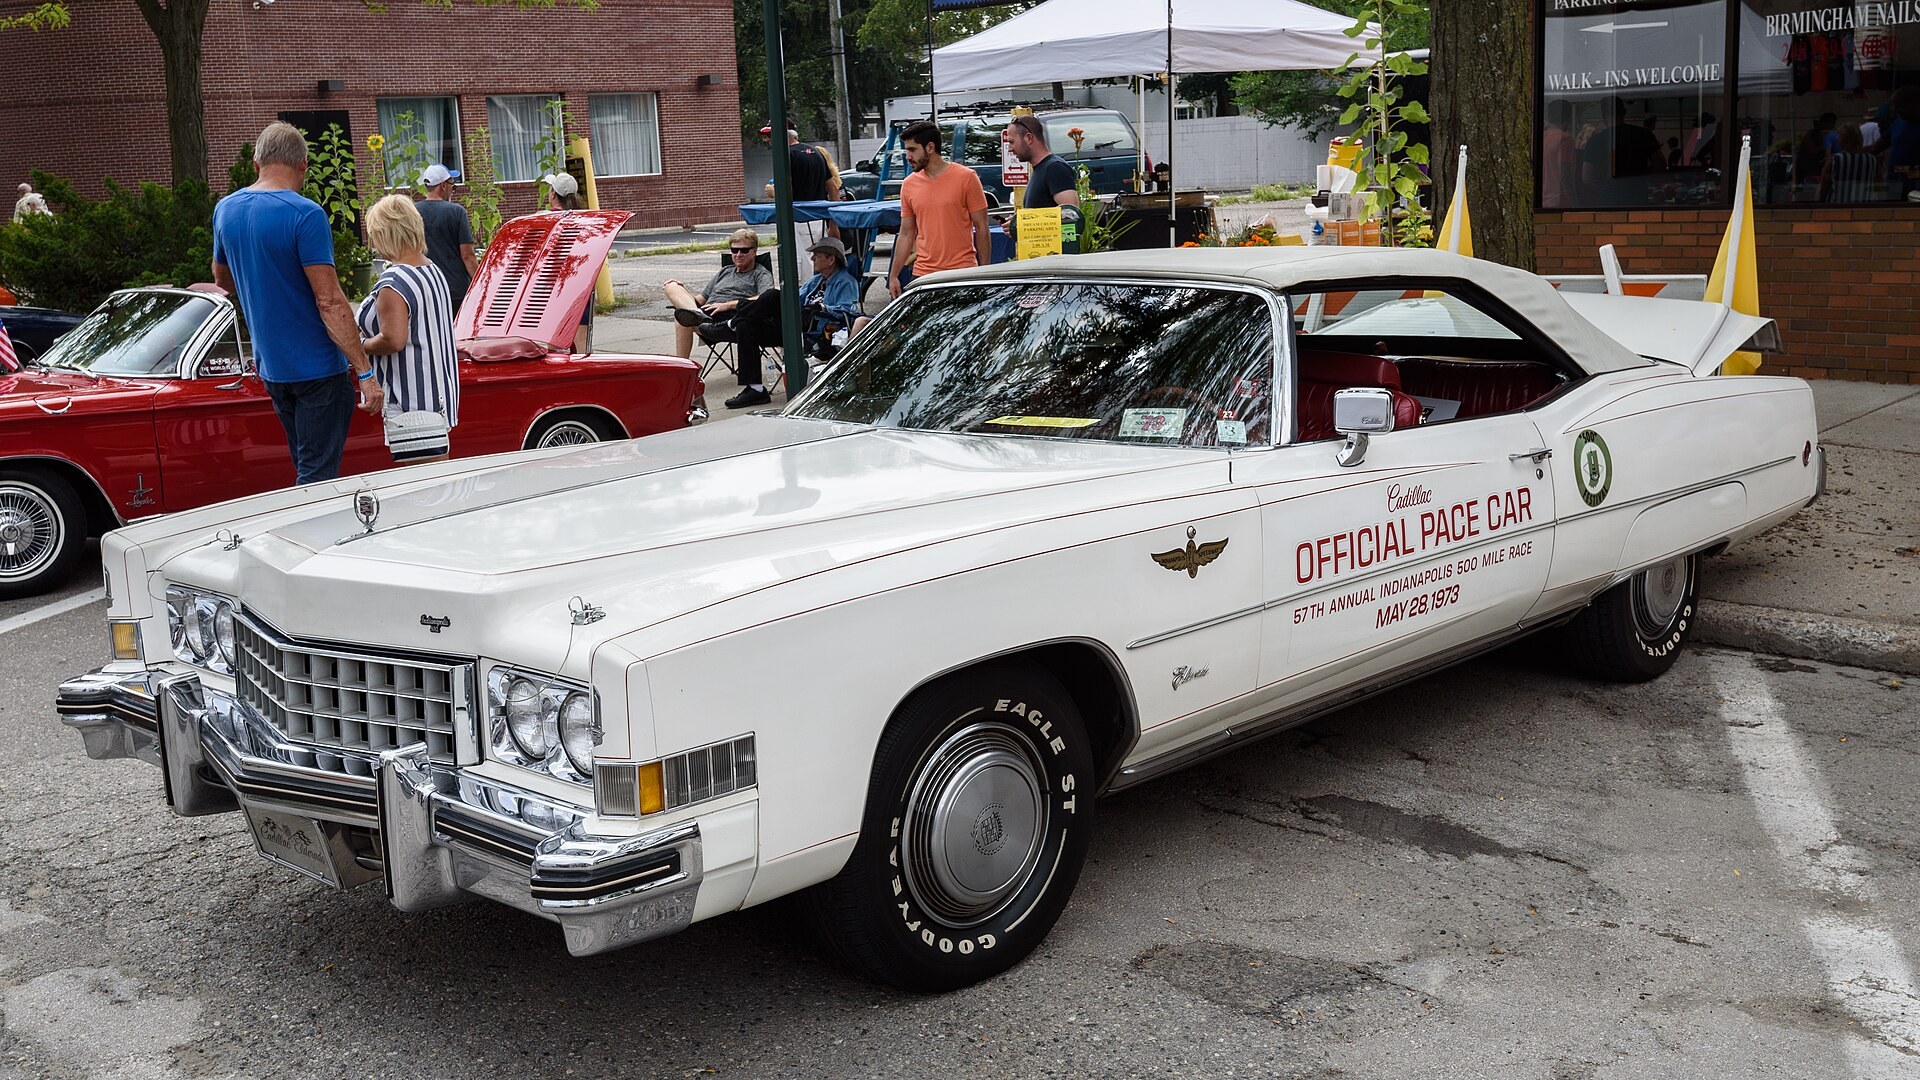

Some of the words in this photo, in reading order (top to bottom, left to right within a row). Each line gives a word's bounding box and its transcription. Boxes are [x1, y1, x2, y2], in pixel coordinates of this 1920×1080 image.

[1765, 4, 1869, 37] BIRMINGHAM
[1549, 72, 1592, 91] WALK
[1604, 69, 1630, 88] INS
[1635, 63, 1720, 85] WELCOME
[1386, 483, 1432, 513] Cadillac
[1582, 485, 1609, 506] FESTIVAL
[1296, 518, 1415, 584] OFFICIAL
[1421, 500, 1480, 550] PACE
[1488, 487, 1533, 531] CAR
[1293, 603, 1324, 625] 57TH
[1329, 587, 1376, 615] ANNUAL
[1380, 564, 1453, 598] INDIANAPOLIS
[1457, 556, 1478, 575] 500
[1482, 548, 1505, 568] MILE
[1508, 540, 1533, 560] RACE
[1375, 601, 1410, 629] MAY
[994, 699, 1066, 755] EAGLE
[1061, 774, 1076, 814] ST
[889, 817, 996, 955] GOODYEAR
